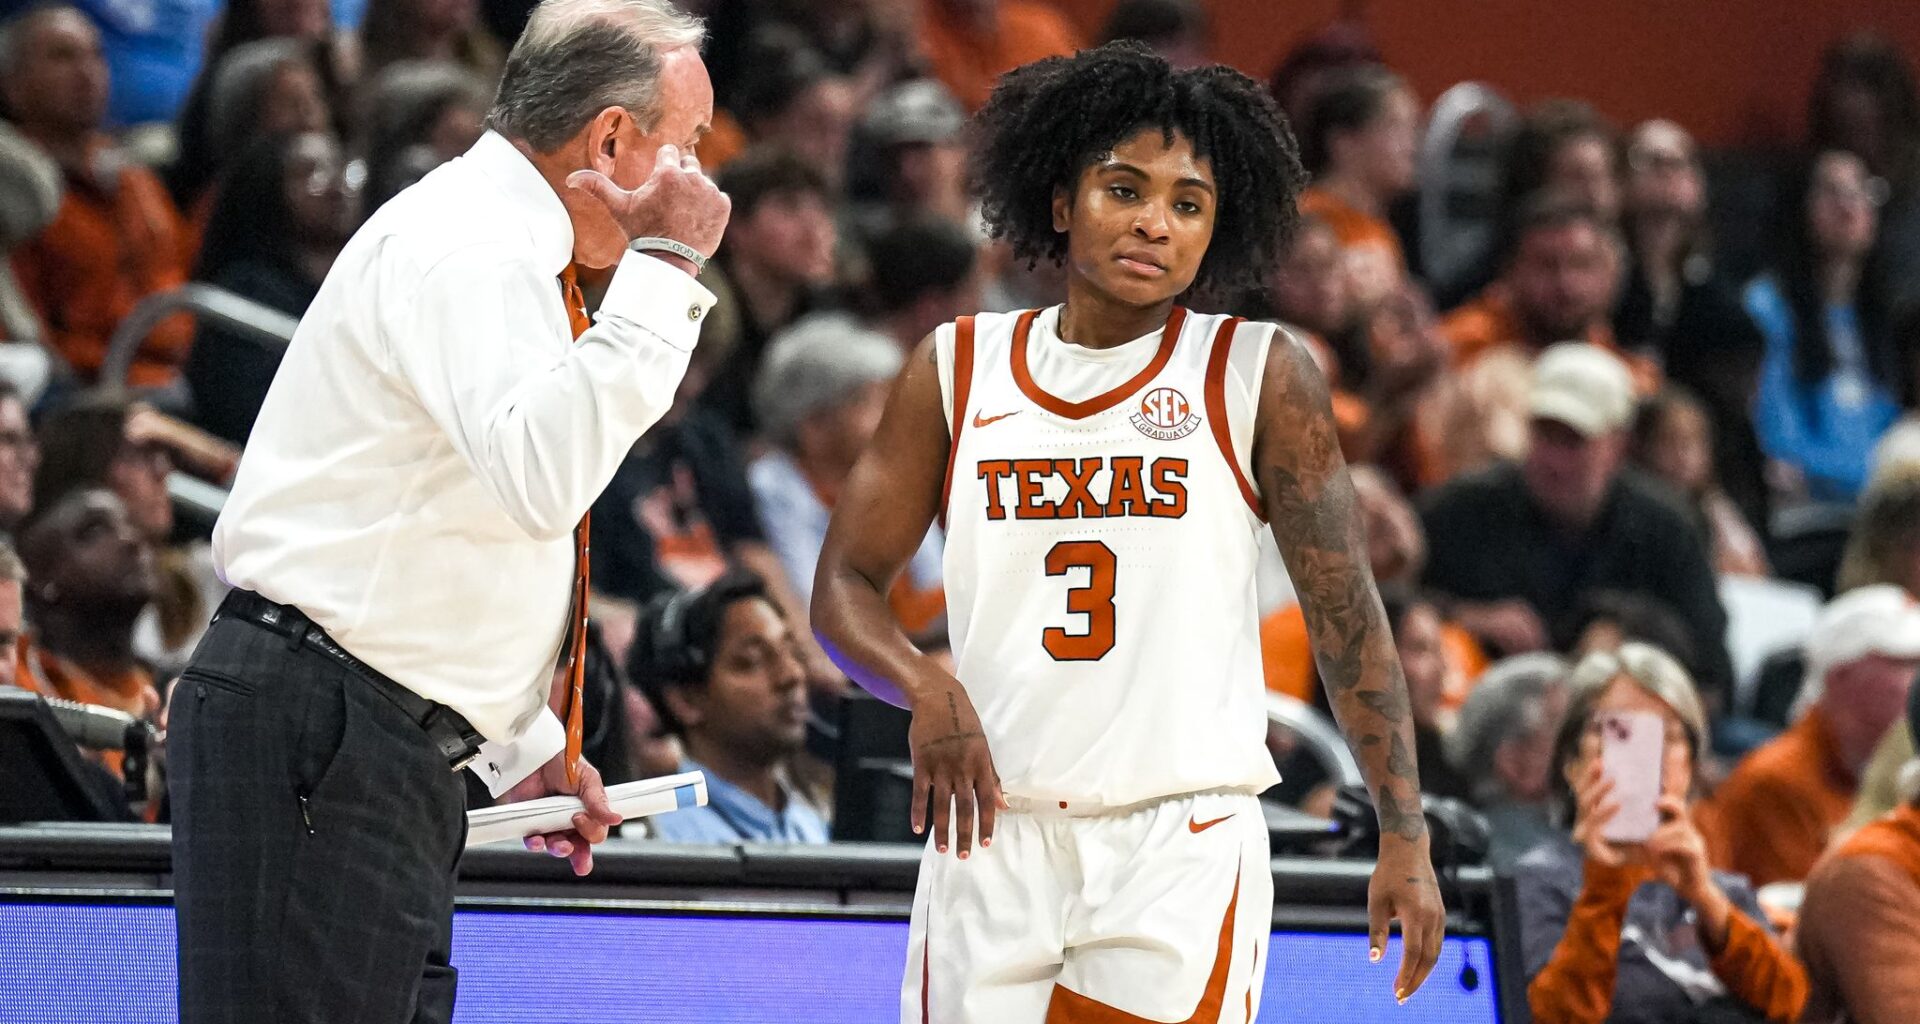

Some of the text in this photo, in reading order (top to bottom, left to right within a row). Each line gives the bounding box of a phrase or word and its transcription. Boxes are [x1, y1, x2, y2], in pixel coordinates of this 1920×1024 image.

[1138, 423, 1192, 440] GRADUATE
[1142, 388, 1189, 427] SEC
[977, 456, 1189, 520] TEXAS
[1042, 540, 1117, 661] 3
